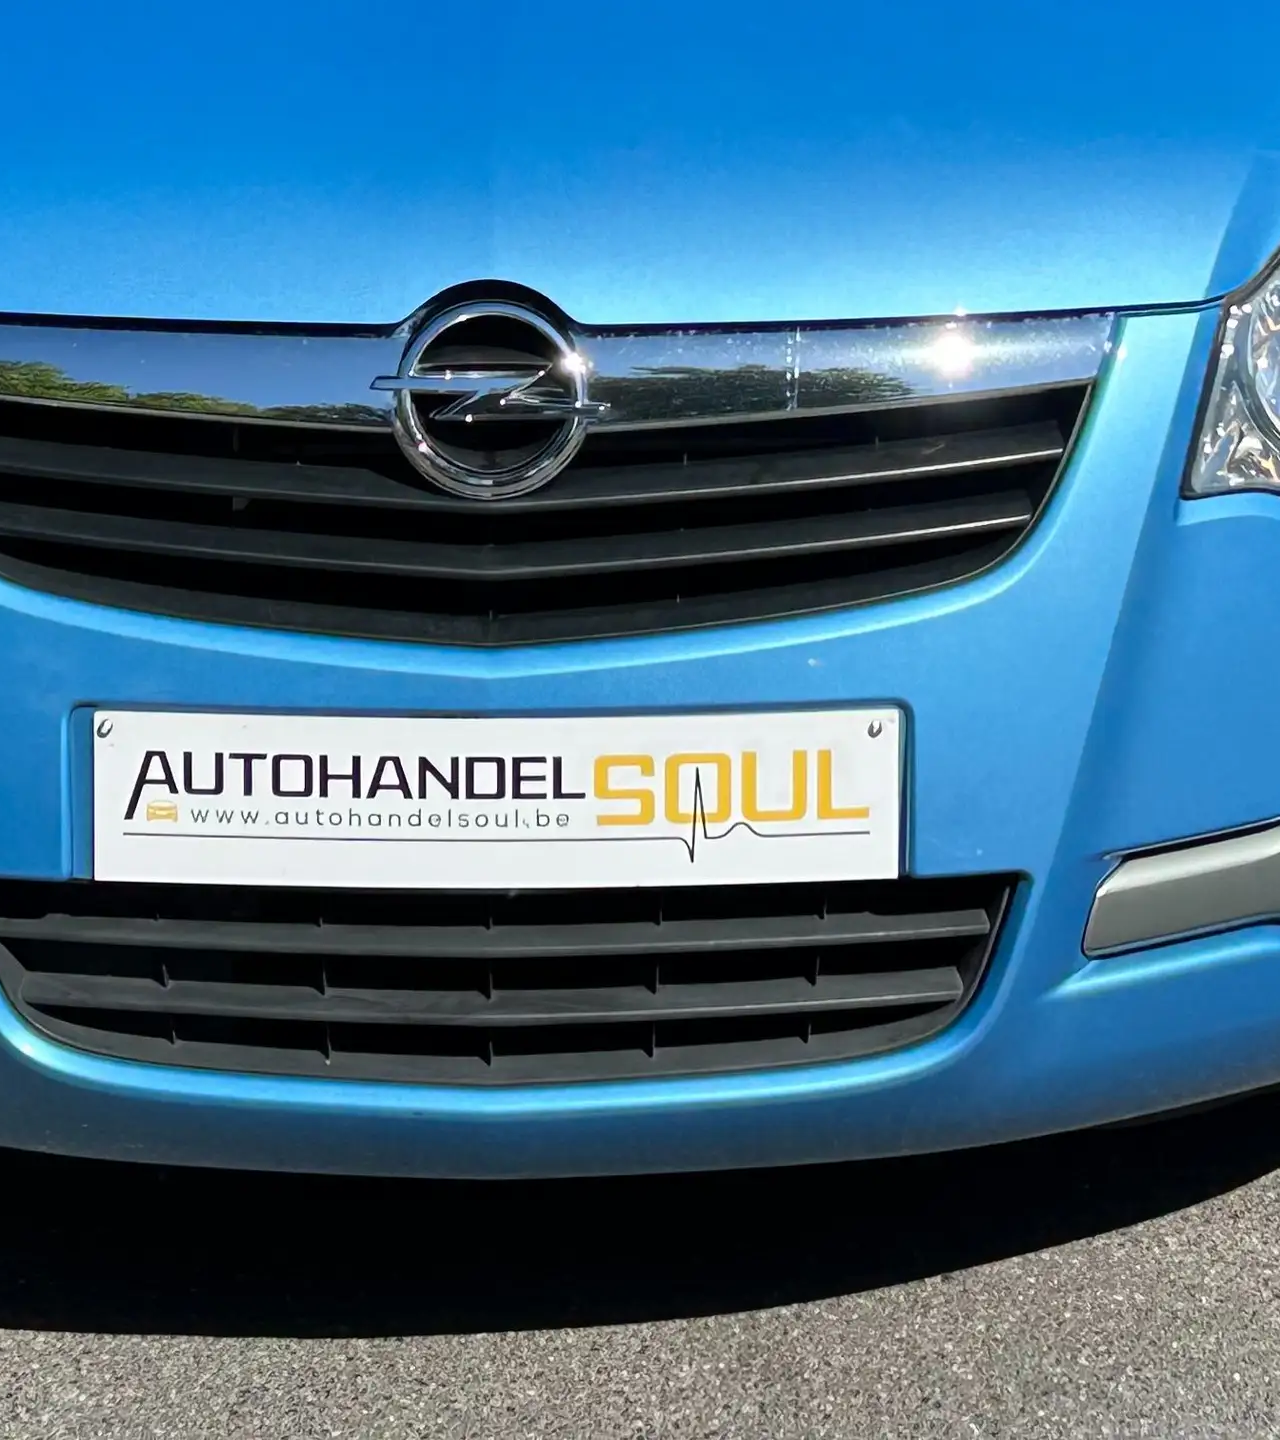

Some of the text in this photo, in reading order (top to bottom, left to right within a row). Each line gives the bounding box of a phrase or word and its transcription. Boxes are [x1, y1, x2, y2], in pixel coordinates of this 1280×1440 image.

[123, 749, 870, 826] AUTOHANDEL SOUL
[190, 806, 571, 829] www.autohandelsoul.be
